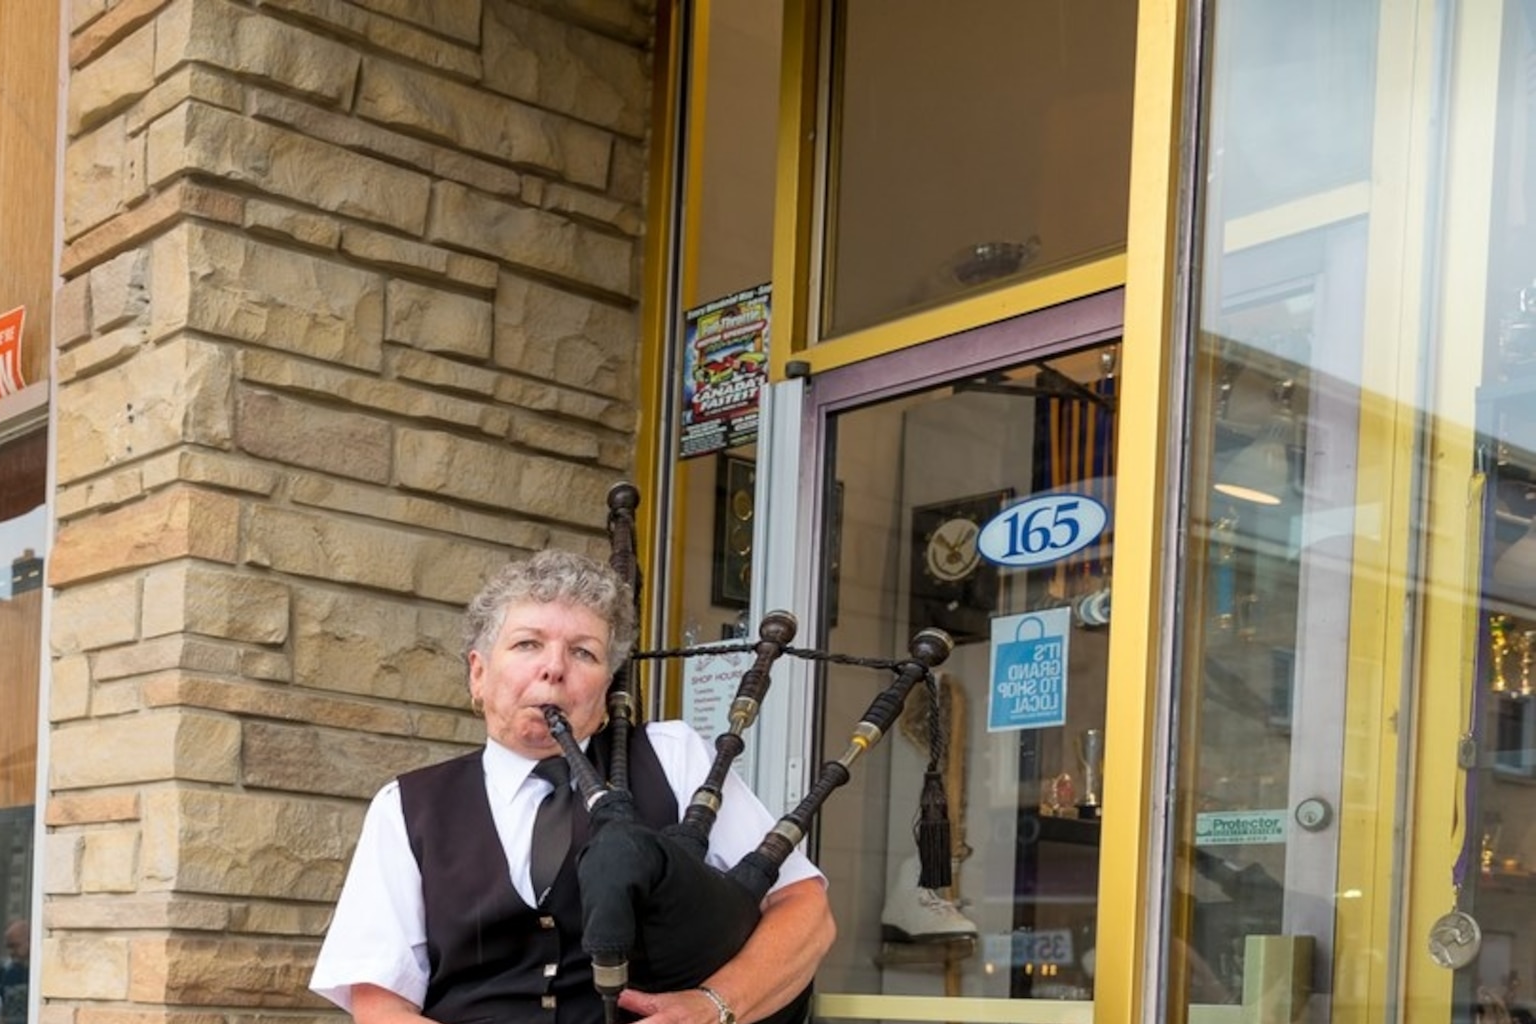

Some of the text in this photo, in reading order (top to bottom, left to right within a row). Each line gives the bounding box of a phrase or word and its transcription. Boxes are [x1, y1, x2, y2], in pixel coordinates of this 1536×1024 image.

[1001, 501, 1080, 558] 165
[691, 674, 713, 684] SHOP
[1213, 818, 1281, 830] Protector
